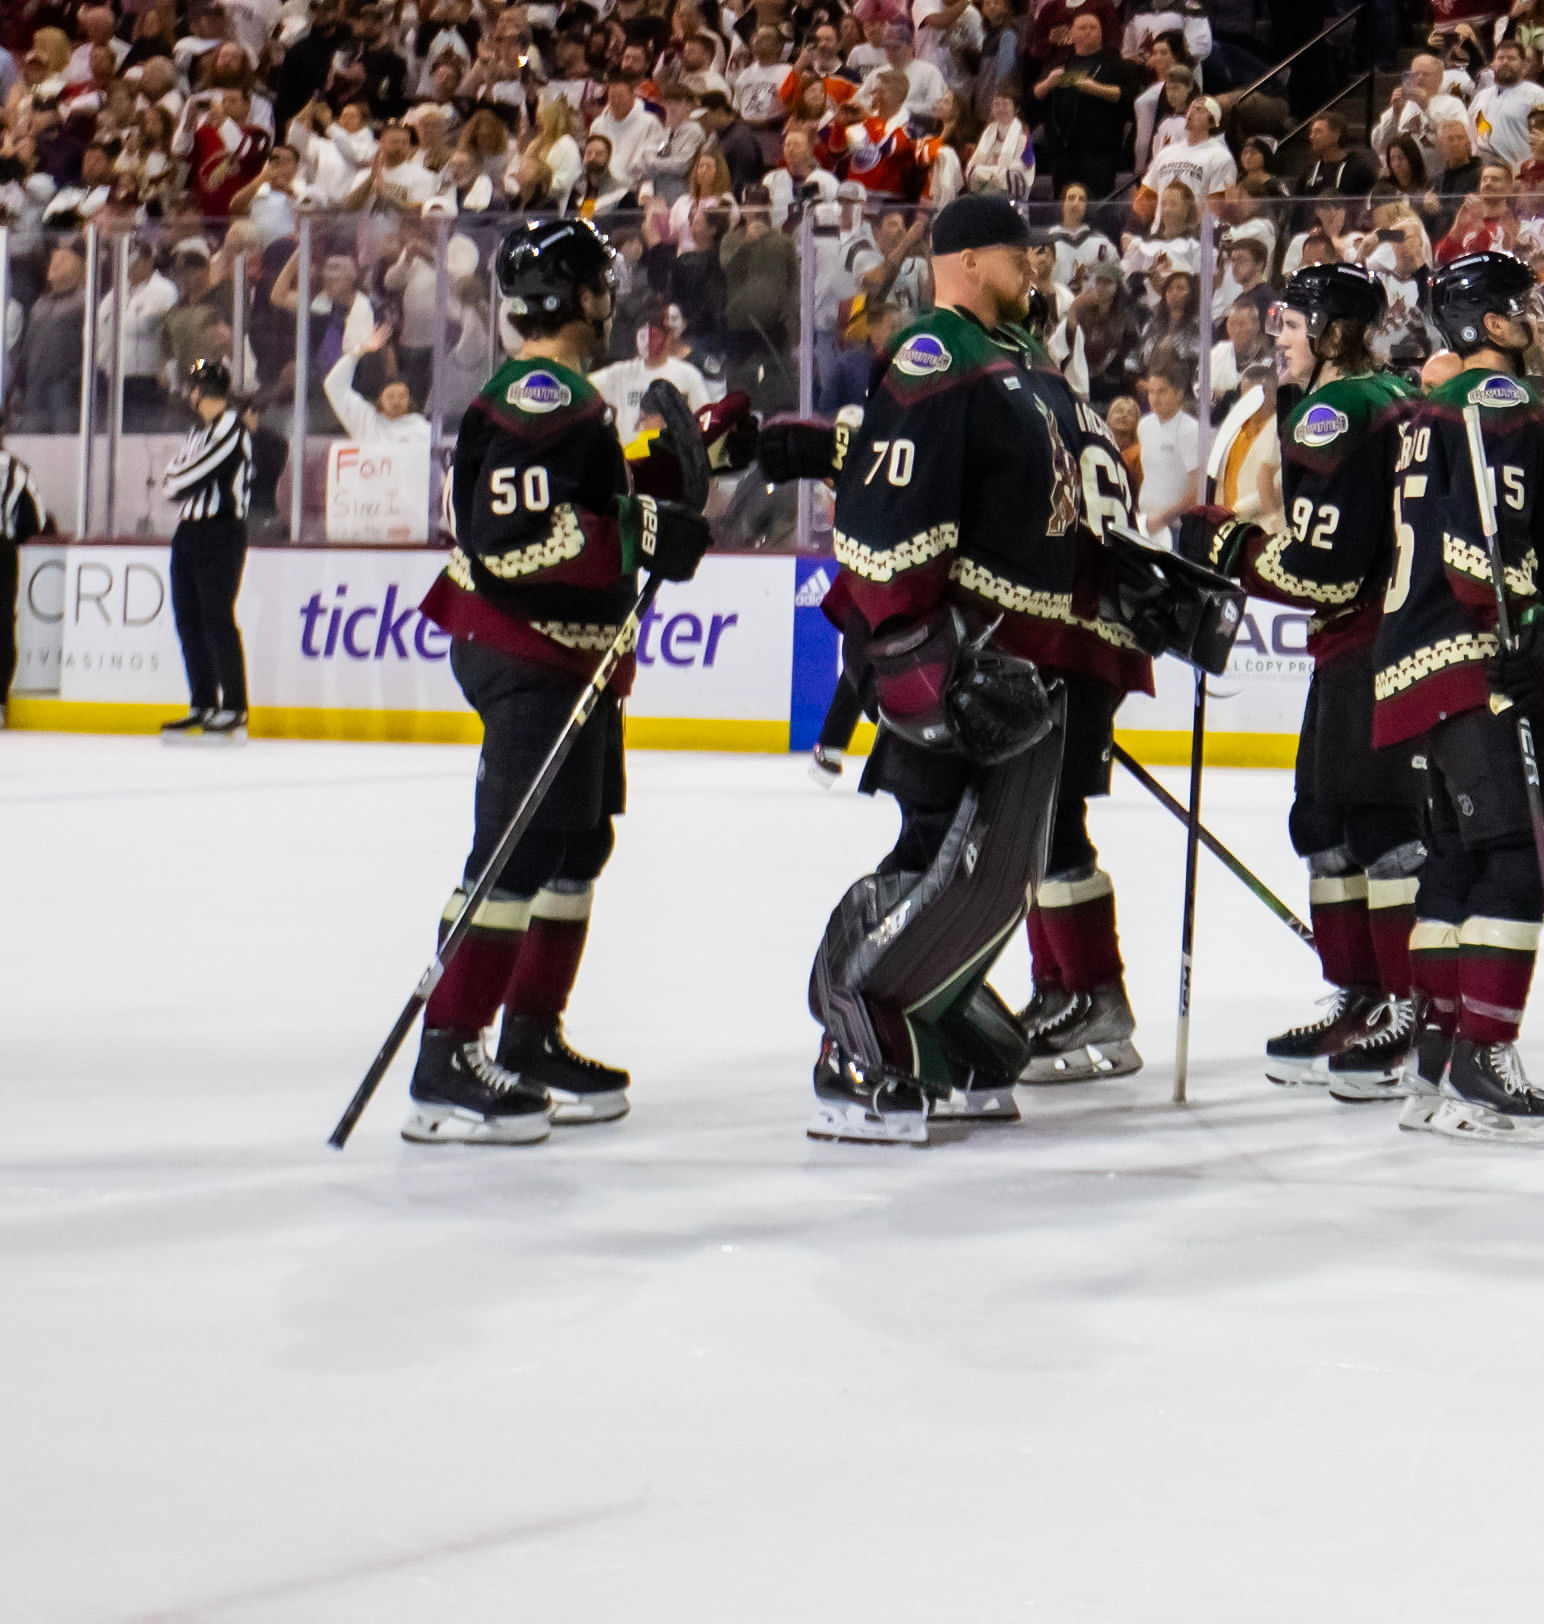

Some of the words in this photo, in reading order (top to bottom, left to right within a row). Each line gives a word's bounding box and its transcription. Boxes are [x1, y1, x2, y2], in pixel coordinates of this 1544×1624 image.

[864, 439, 916, 487] 70
[490, 465, 550, 515] 50
[1292, 497, 1341, 551] 92
